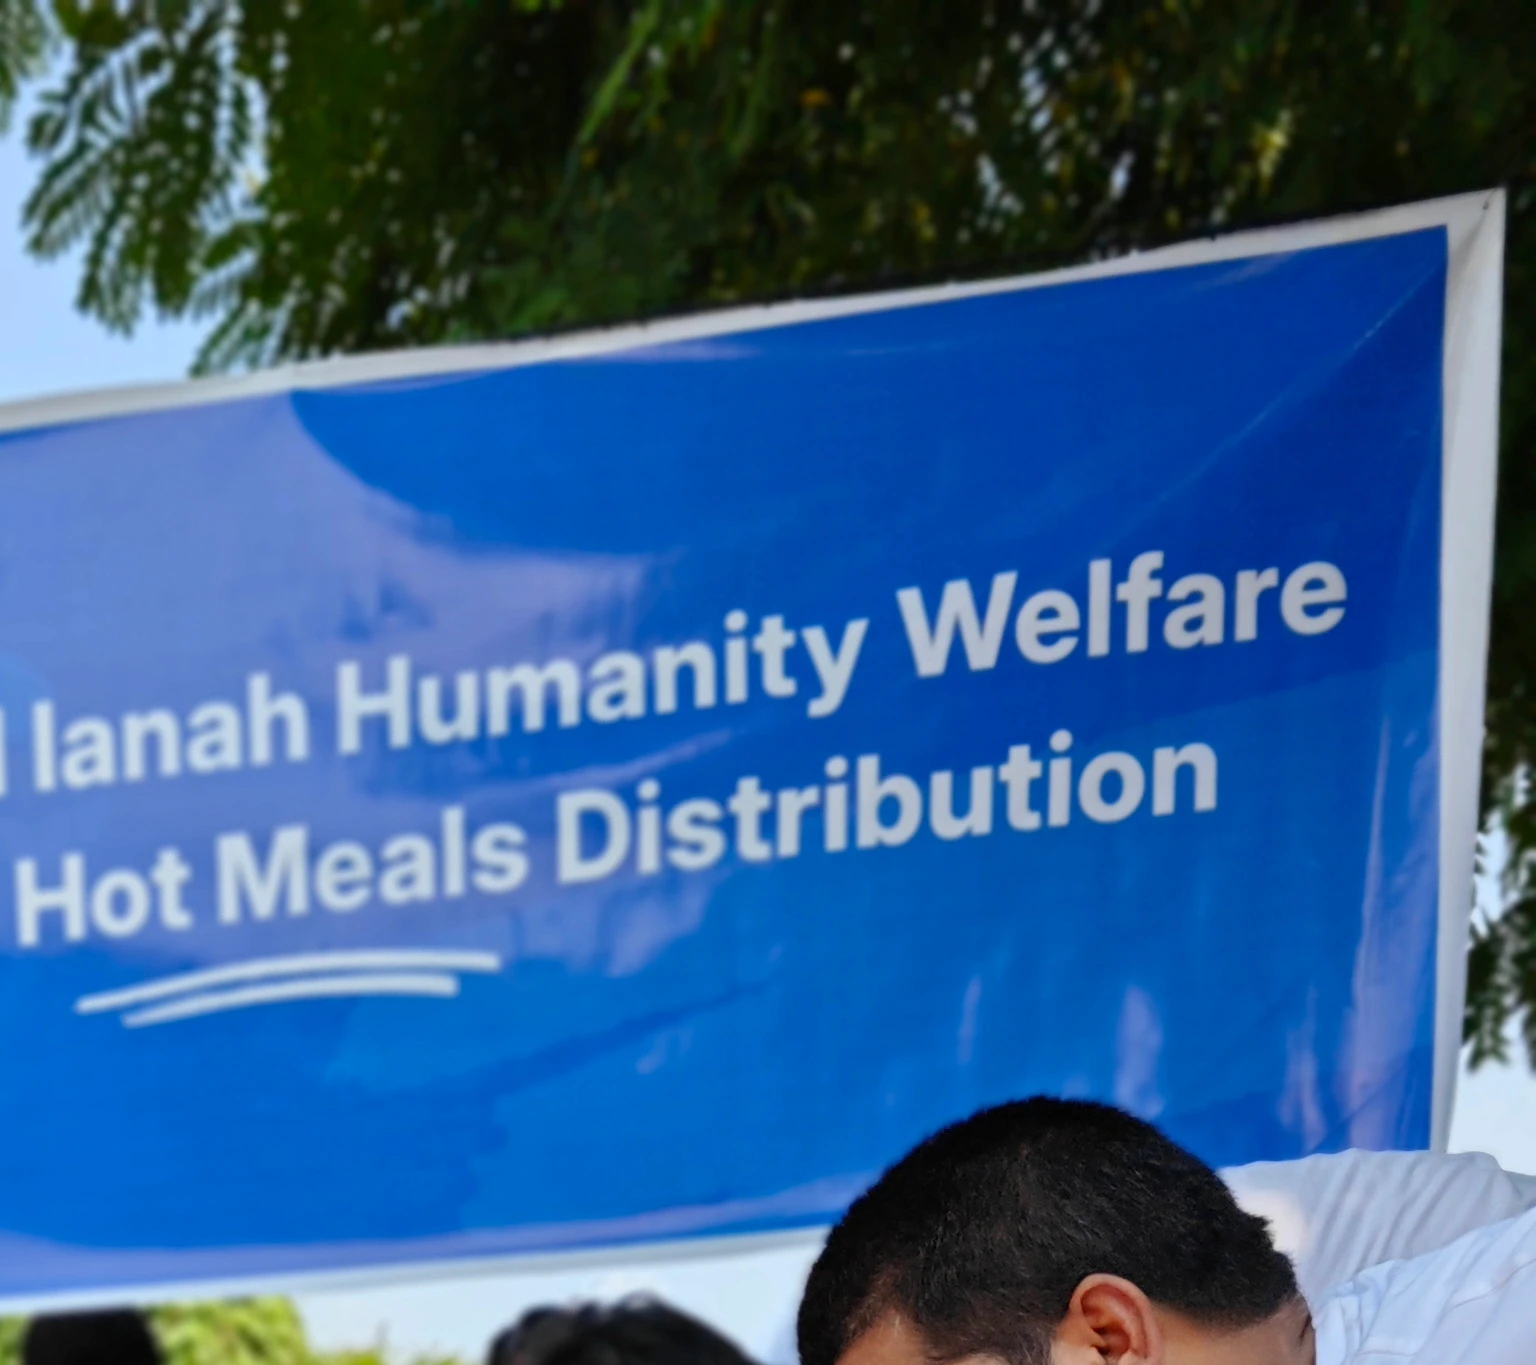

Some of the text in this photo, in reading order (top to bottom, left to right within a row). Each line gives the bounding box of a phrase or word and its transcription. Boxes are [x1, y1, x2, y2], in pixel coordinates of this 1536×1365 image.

[329, 611, 867, 775] Humanity
[897, 554, 1346, 677] Welfare
[16, 744, 1216, 945] Hot Meals Distribution
